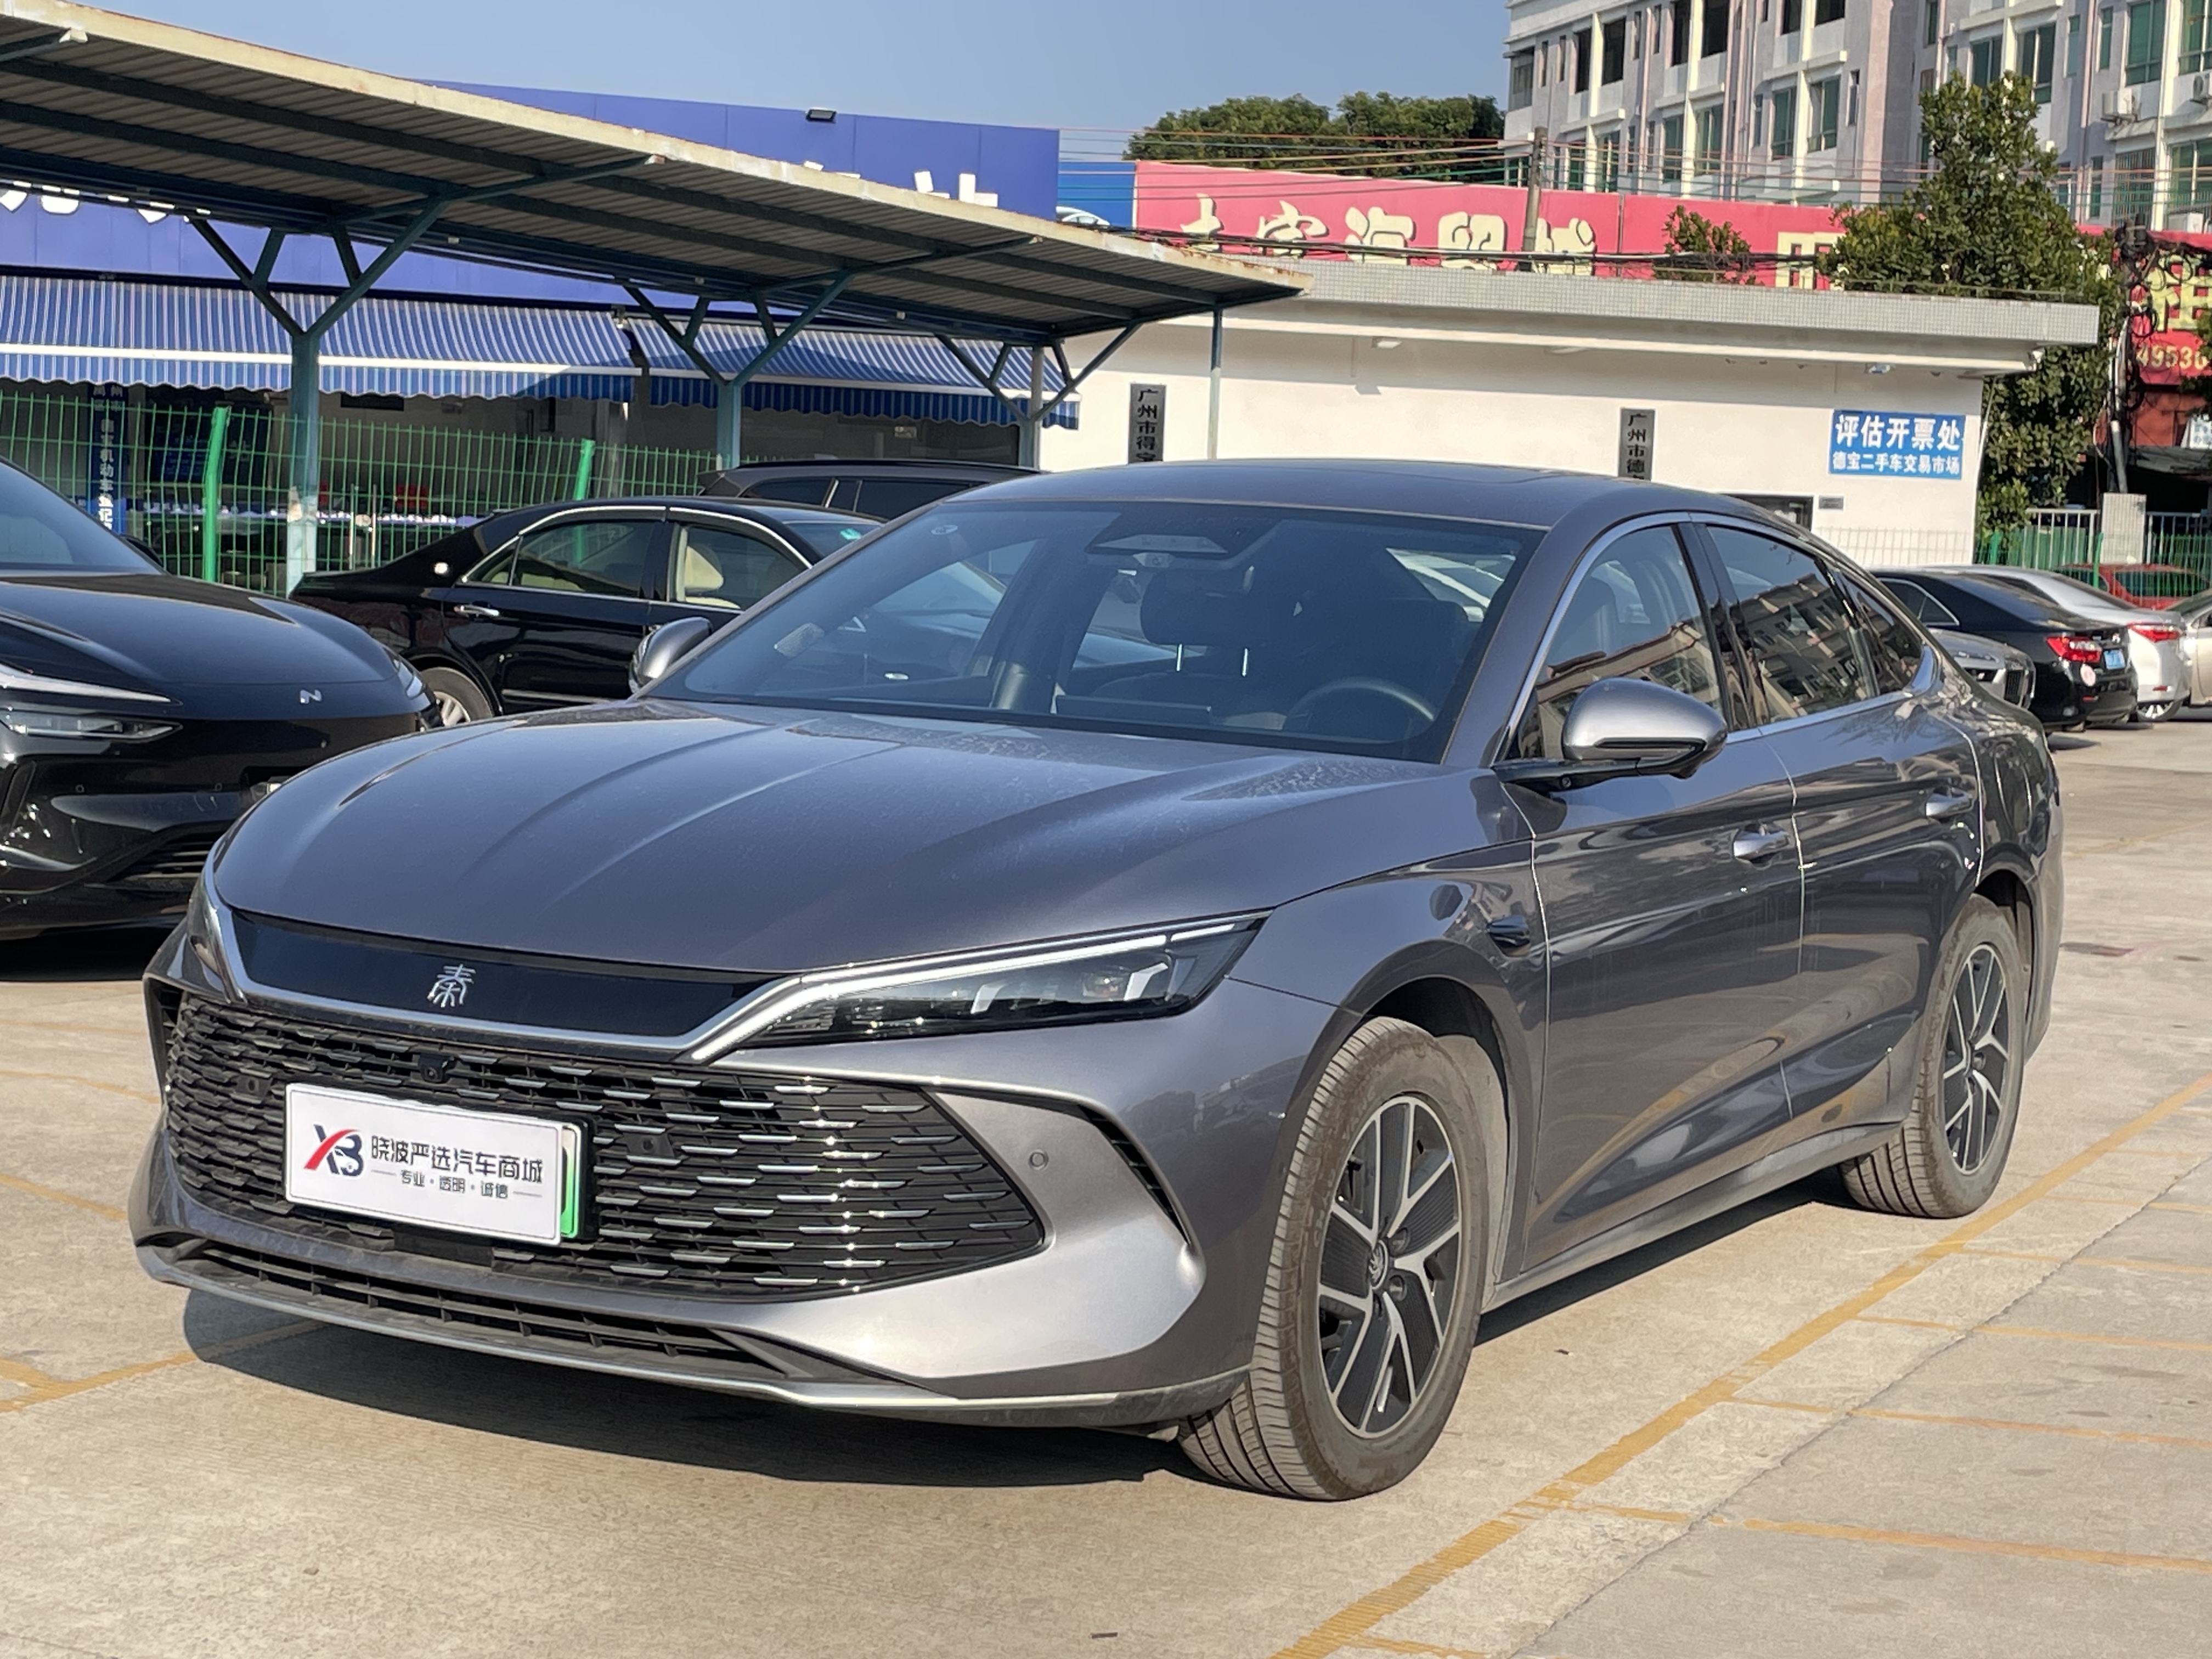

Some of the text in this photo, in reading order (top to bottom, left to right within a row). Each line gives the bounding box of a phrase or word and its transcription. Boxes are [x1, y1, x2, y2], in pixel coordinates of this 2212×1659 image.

[1627, 413, 1647, 480] 广州市德
[1835, 414, 1960, 450] 评估开票处
[1832, 451, 1959, 475] 德宝二手车交易市场
[371, 1136, 543, 1183] 晓波严选汽车商城
